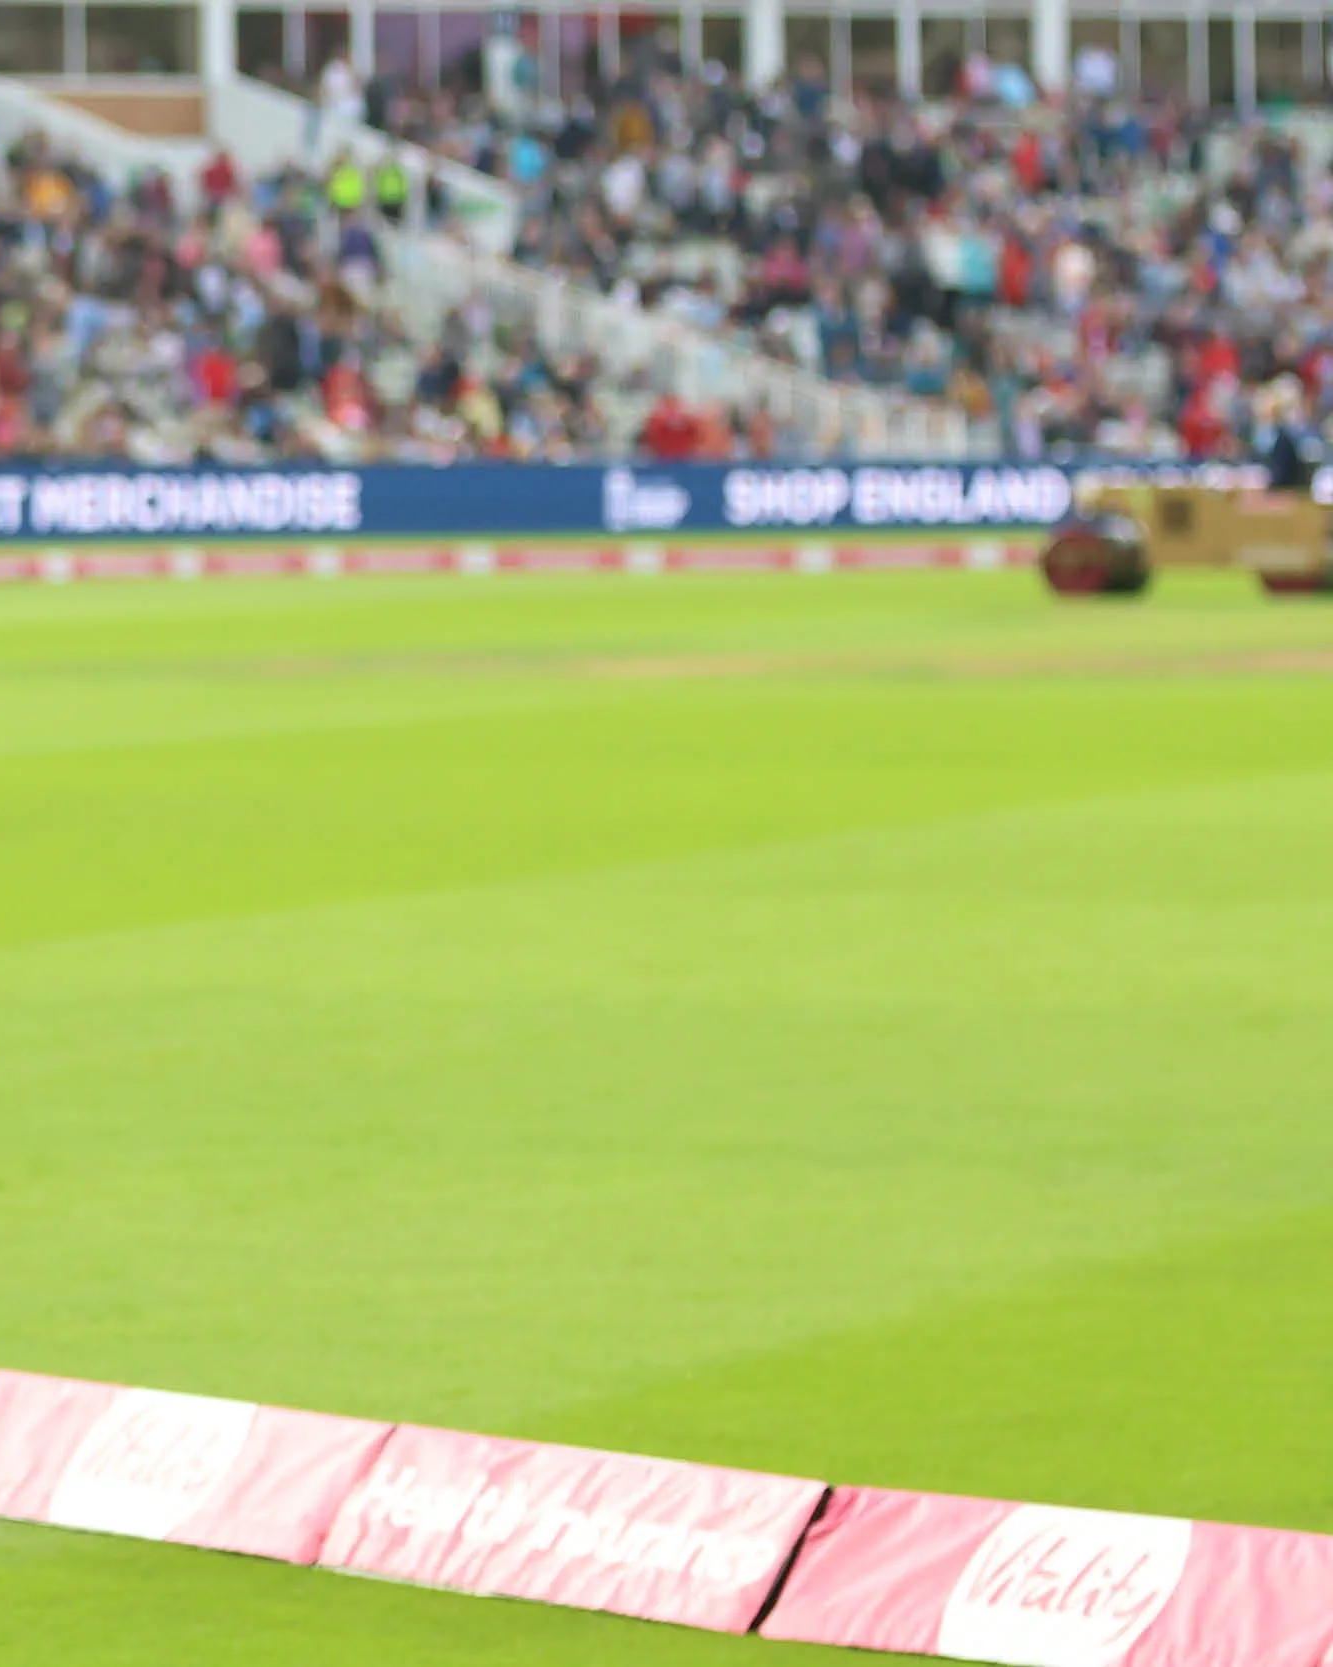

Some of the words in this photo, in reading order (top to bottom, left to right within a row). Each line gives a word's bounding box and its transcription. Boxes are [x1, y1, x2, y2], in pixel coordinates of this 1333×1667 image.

[31, 472, 363, 533] MERCHANDISE
[723, 467, 849, 526] SHOP
[852, 464, 1073, 525] ENGLAND
[964, 1522, 1160, 1647] Vitality
